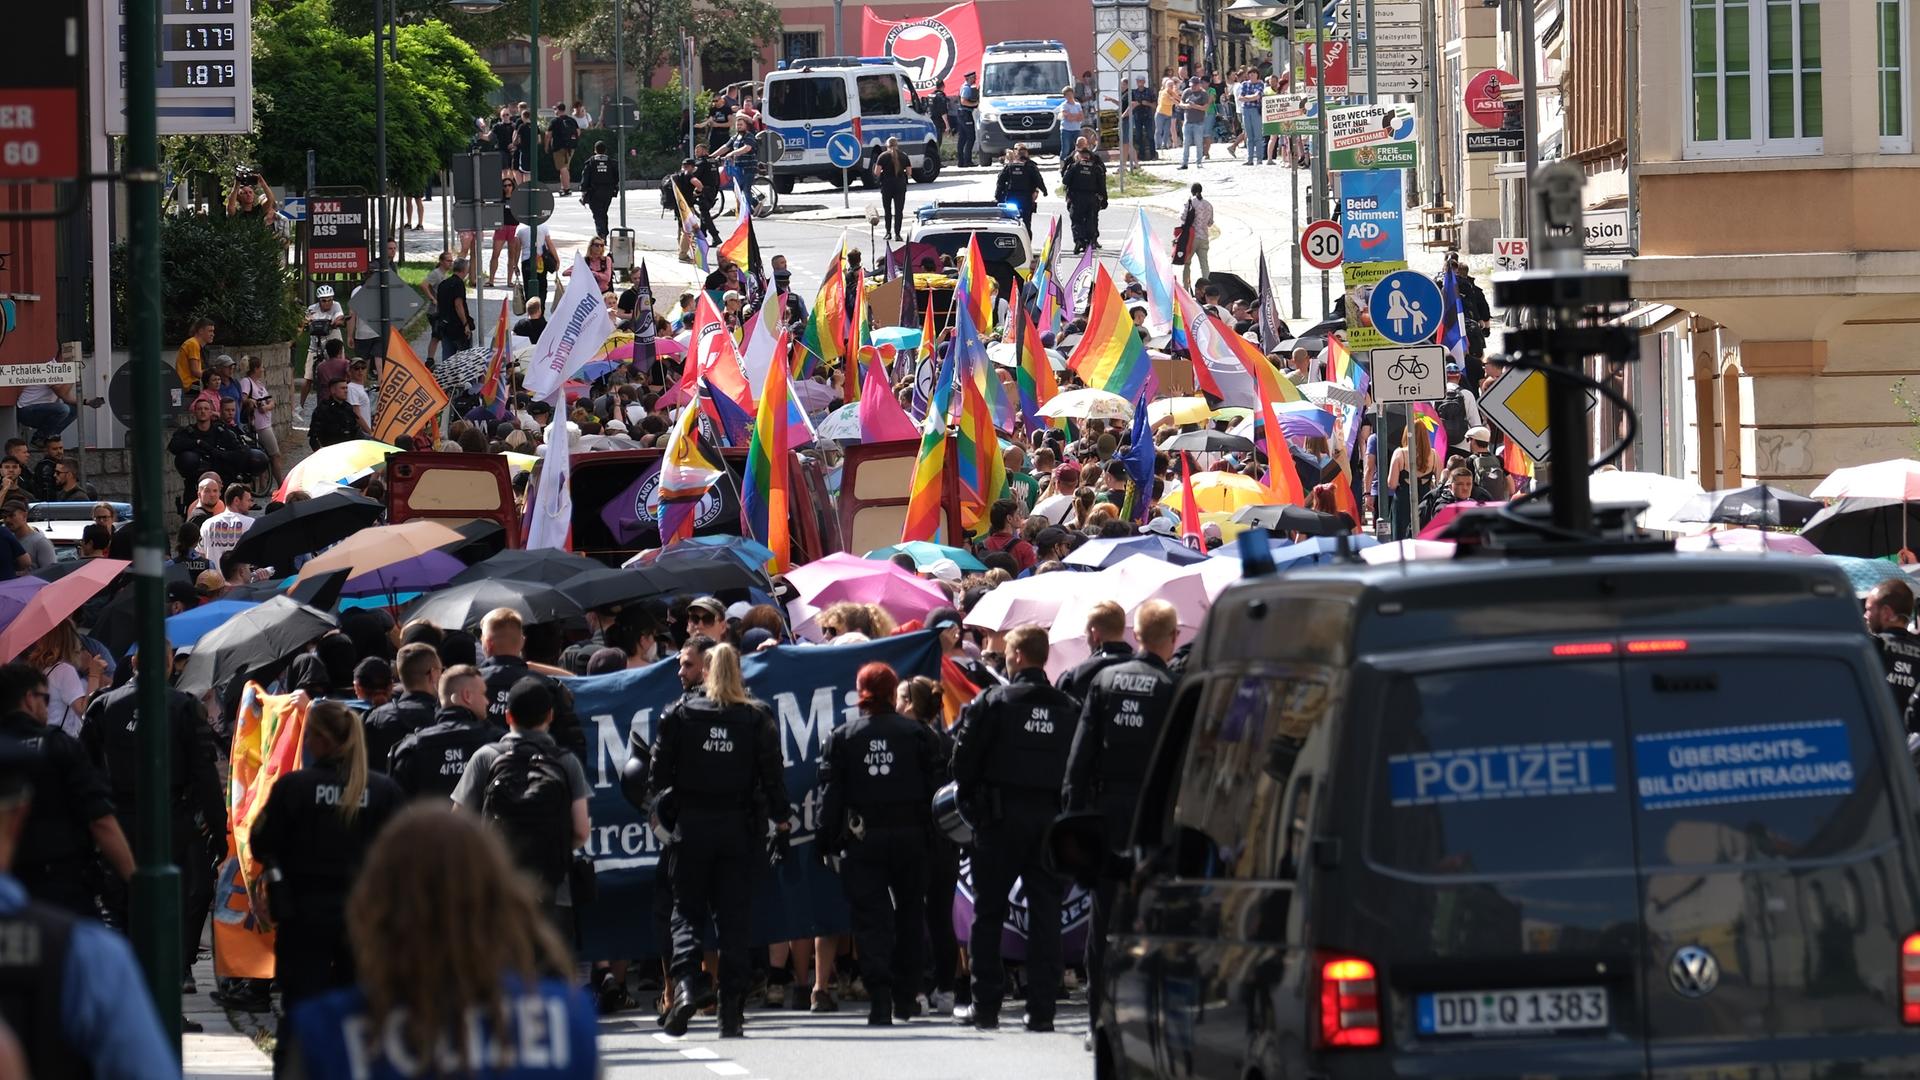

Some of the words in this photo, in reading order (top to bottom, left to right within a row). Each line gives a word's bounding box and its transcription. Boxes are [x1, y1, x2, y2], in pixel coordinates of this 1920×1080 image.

[186, 28, 233, 47] 1.779
[187, 65, 234, 84] 1.879
[1332, 114, 1346, 122] DER
[1347, 108, 1388, 119] WECHSEL
[1353, 119, 1369, 127] NUR
[1333, 129, 1347, 137] MIT
[4, 142, 39, 166] 60
[1377, 147, 1399, 155] FREIE
[1377, 154, 1413, 162] SACHSEN
[1346, 199, 1377, 210] Beide
[1347, 210, 1399, 221] Stimmen:
[313, 225, 338, 236] ASS
[1347, 222, 1380, 239] AfD
[1312, 235, 1339, 256] 30
[1398, 383, 1421, 395] frei
[1893, 660, 1912, 673] SN
[1112, 673, 1158, 692] POLIZEI
[1121, 700, 1139, 712] SN
[1031, 708, 1049, 720] SN
[1113, 714, 1144, 727] 4/100
[709, 727, 728, 739] SN
[1024, 721, 1054, 733] 4/120
[702, 740, 733, 753] 4/120
[869, 740, 887, 752] SN
[445, 749, 463, 761] SN
[863, 752, 893, 764] 4/130
[1414, 750, 1591, 797] POLIZEI
[1638, 760, 1854, 798] BILDÜBERTRAGUNG
[1438, 996, 1478, 1027] DD
[1526, 992, 1603, 1023] 1383
